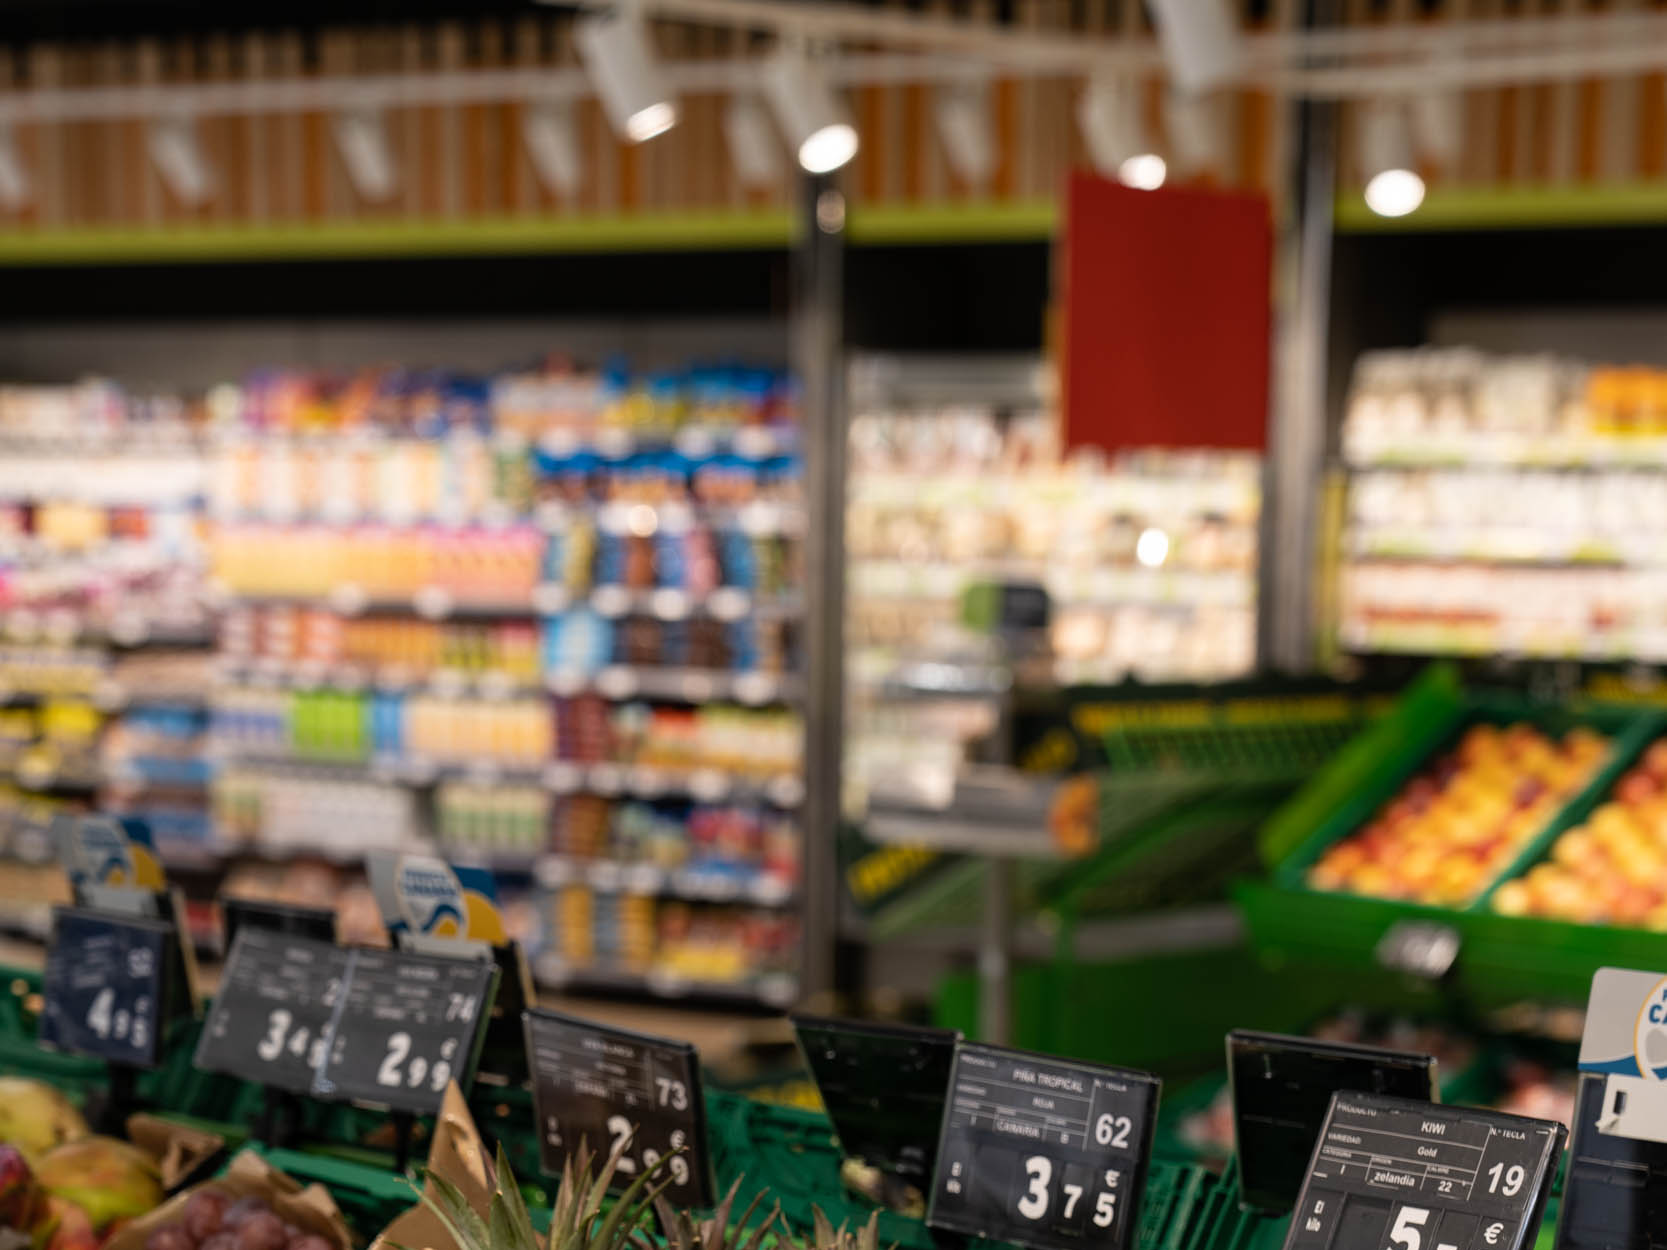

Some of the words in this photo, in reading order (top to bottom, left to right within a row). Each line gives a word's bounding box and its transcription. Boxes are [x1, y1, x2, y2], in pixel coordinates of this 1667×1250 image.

[87, 987, 115, 1039] 4
[257, 1009, 293, 1062] 3
[376, 1031, 412, 1087] 2
[655, 1076, 688, 1111] 73
[1038, 1072, 1084, 1093] TROPICAL
[1094, 1112, 1133, 1149] 62
[1420, 1120, 1447, 1137] KIWI
[1417, 1145, 1439, 1159] Gold
[1017, 1155, 1053, 1220] 3
[1373, 1171, 1416, 1188] zelandia
[1437, 1180, 1454, 1194] 22
[1488, 1161, 1526, 1197] 19
